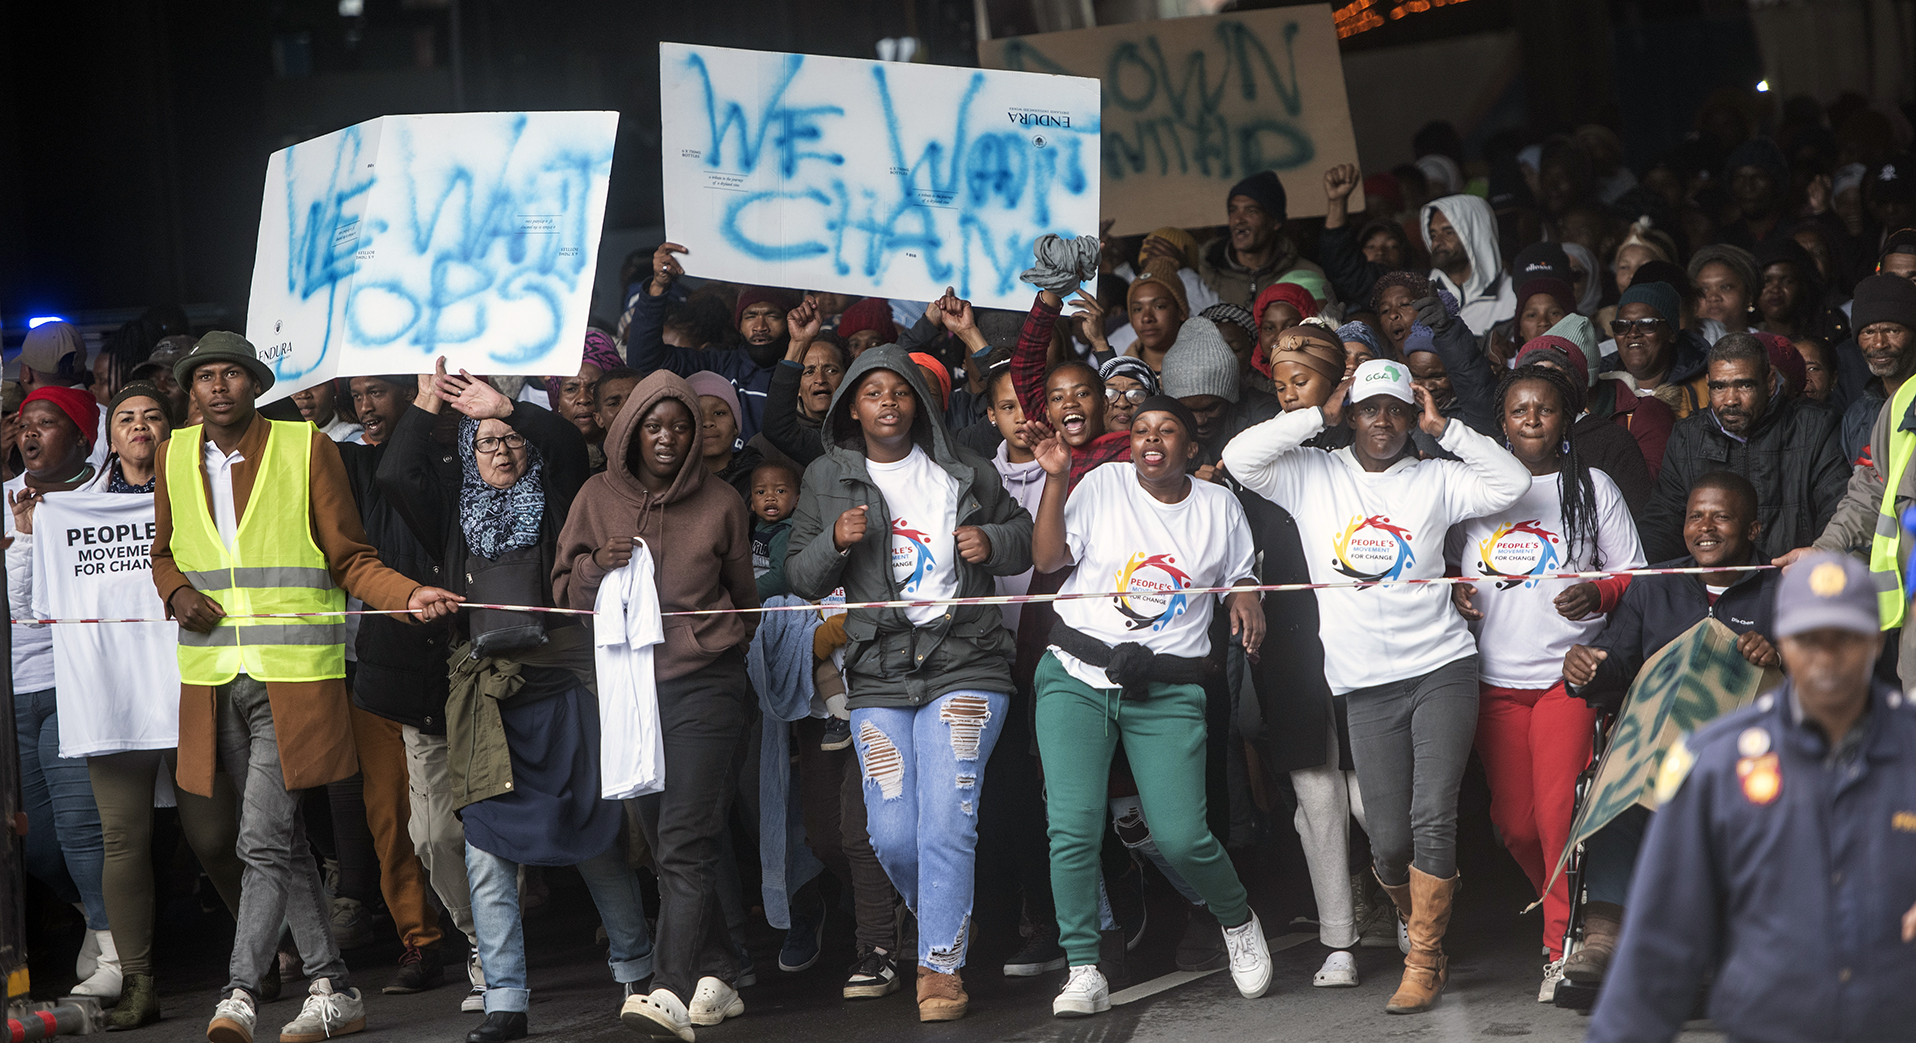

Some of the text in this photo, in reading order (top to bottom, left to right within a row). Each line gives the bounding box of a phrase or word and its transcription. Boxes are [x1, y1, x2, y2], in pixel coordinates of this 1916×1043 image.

[685, 52, 845, 178] WE
[1007, 112, 1071, 128] ENDURA
[283, 125, 388, 300] WE
[719, 178, 1087, 301] CHAN
[258, 341, 293, 361] ENDURA
[1365, 372, 1391, 381] GGA
[1351, 539, 1394, 547] PEOPLE'S
[78, 544, 152, 562] MOVEME
[74, 563, 105, 577] FOR
[1130, 578, 1172, 591] PEOPLE'S
[1142, 595, 1167, 606] CHANGE
